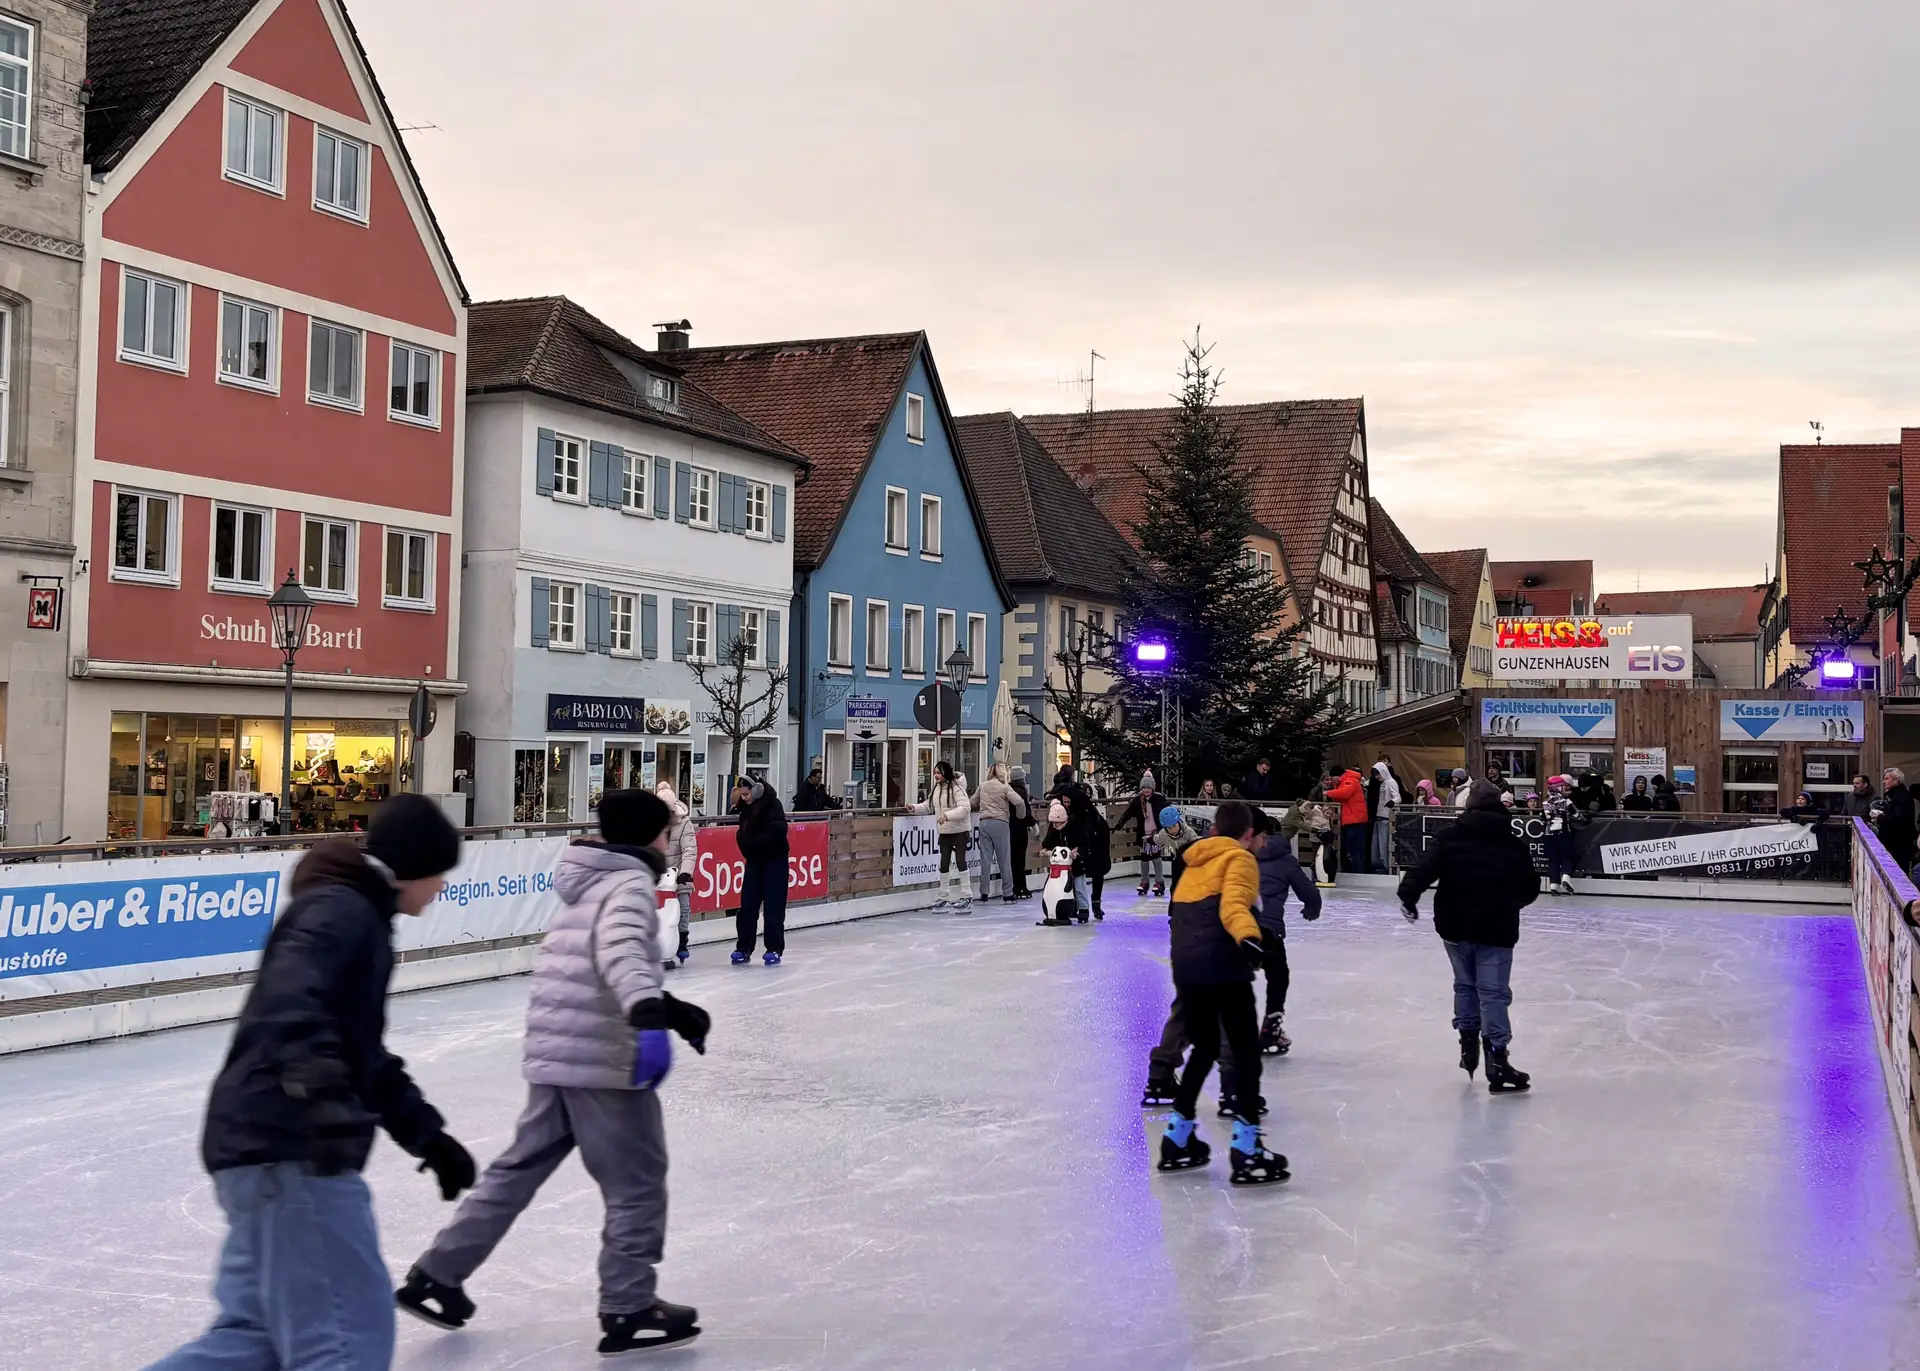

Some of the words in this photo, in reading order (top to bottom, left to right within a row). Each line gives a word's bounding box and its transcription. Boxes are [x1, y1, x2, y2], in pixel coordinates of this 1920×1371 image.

[36, 600, 49, 616] M
[200, 614, 266, 644] Schuh
[305, 624, 362, 650] Bartl
[1498, 621, 1604, 648] HEISS
[1608, 620, 1634, 636] auf
[1498, 655, 1610, 670] GUNZENHAUSEN
[1628, 645, 1686, 672] EIS
[572, 702, 633, 720] BABYLON
[1484, 701, 1613, 715] Schlittschuhverleih
[1734, 704, 1780, 716] Kasse
[1783, 703, 1792, 718] /
[1794, 704, 1849, 717] Eintritt
[1609, 846, 1631, 858] WIR
[1634, 841, 1677, 854] KAUFEN
[1612, 860, 1636, 872] IHRE
[1638, 852, 1698, 870] IMMOBILIE
[1700, 851, 1705, 864] /
[1708, 848, 1727, 860] IHR
[1730, 838, 1810, 858] GRUNDSTÜCK!
[900, 863, 937, 876] Datenschutz
[1707, 862, 1742, 876] 09831
[1746, 861, 1751, 872] /
[1754, 858, 1776, 870] 890
[1778, 856, 1793, 867] 79
[1804, 854, 1811, 864] 0
[438, 878, 494, 906] Region.
[498, 874, 528, 896] Seit
[532, 872, 554, 894] 184
[698, 852, 822, 908] Spasse
[118, 886, 150, 928] &
[158, 877, 276, 924] Riedel
[0, 948, 68, 972] ustoffe
